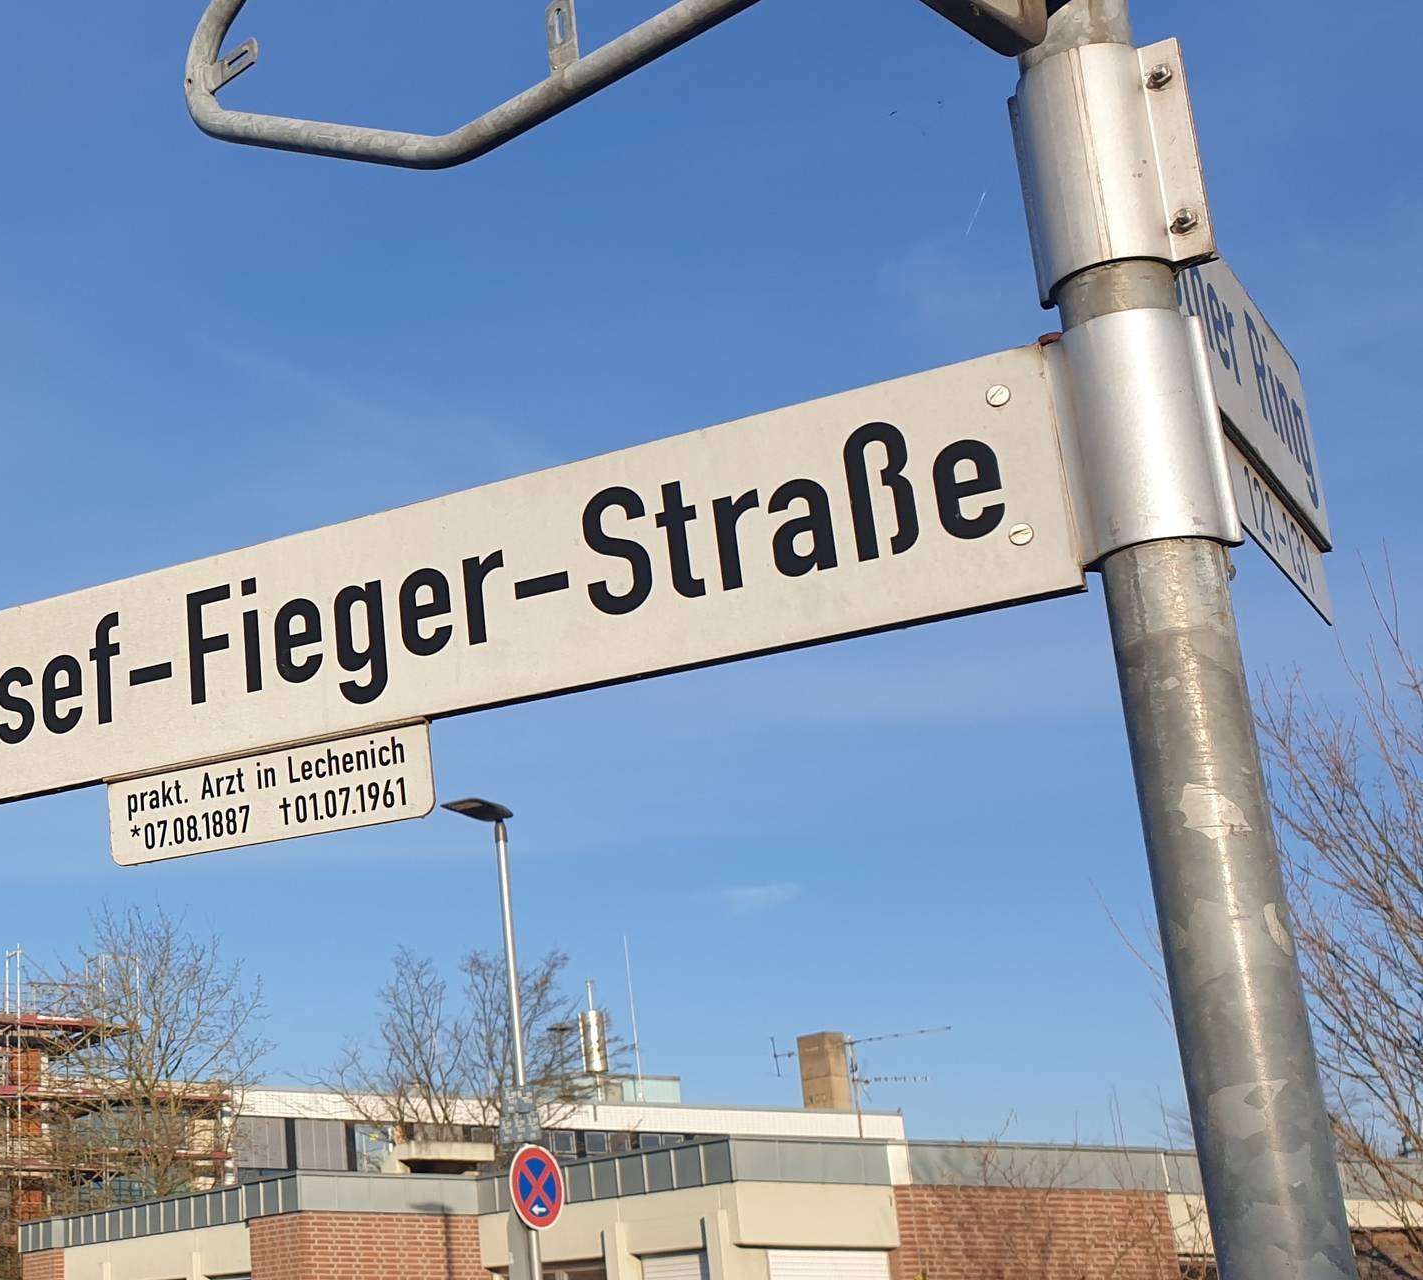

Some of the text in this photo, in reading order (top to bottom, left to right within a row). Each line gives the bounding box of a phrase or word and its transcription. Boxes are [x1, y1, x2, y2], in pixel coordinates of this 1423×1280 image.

[1243, 309, 1319, 509] Ring
[1244, 465, 1315, 594] 121-131
[127, 736, 406, 822] prakt. Arzt in Lechenich
